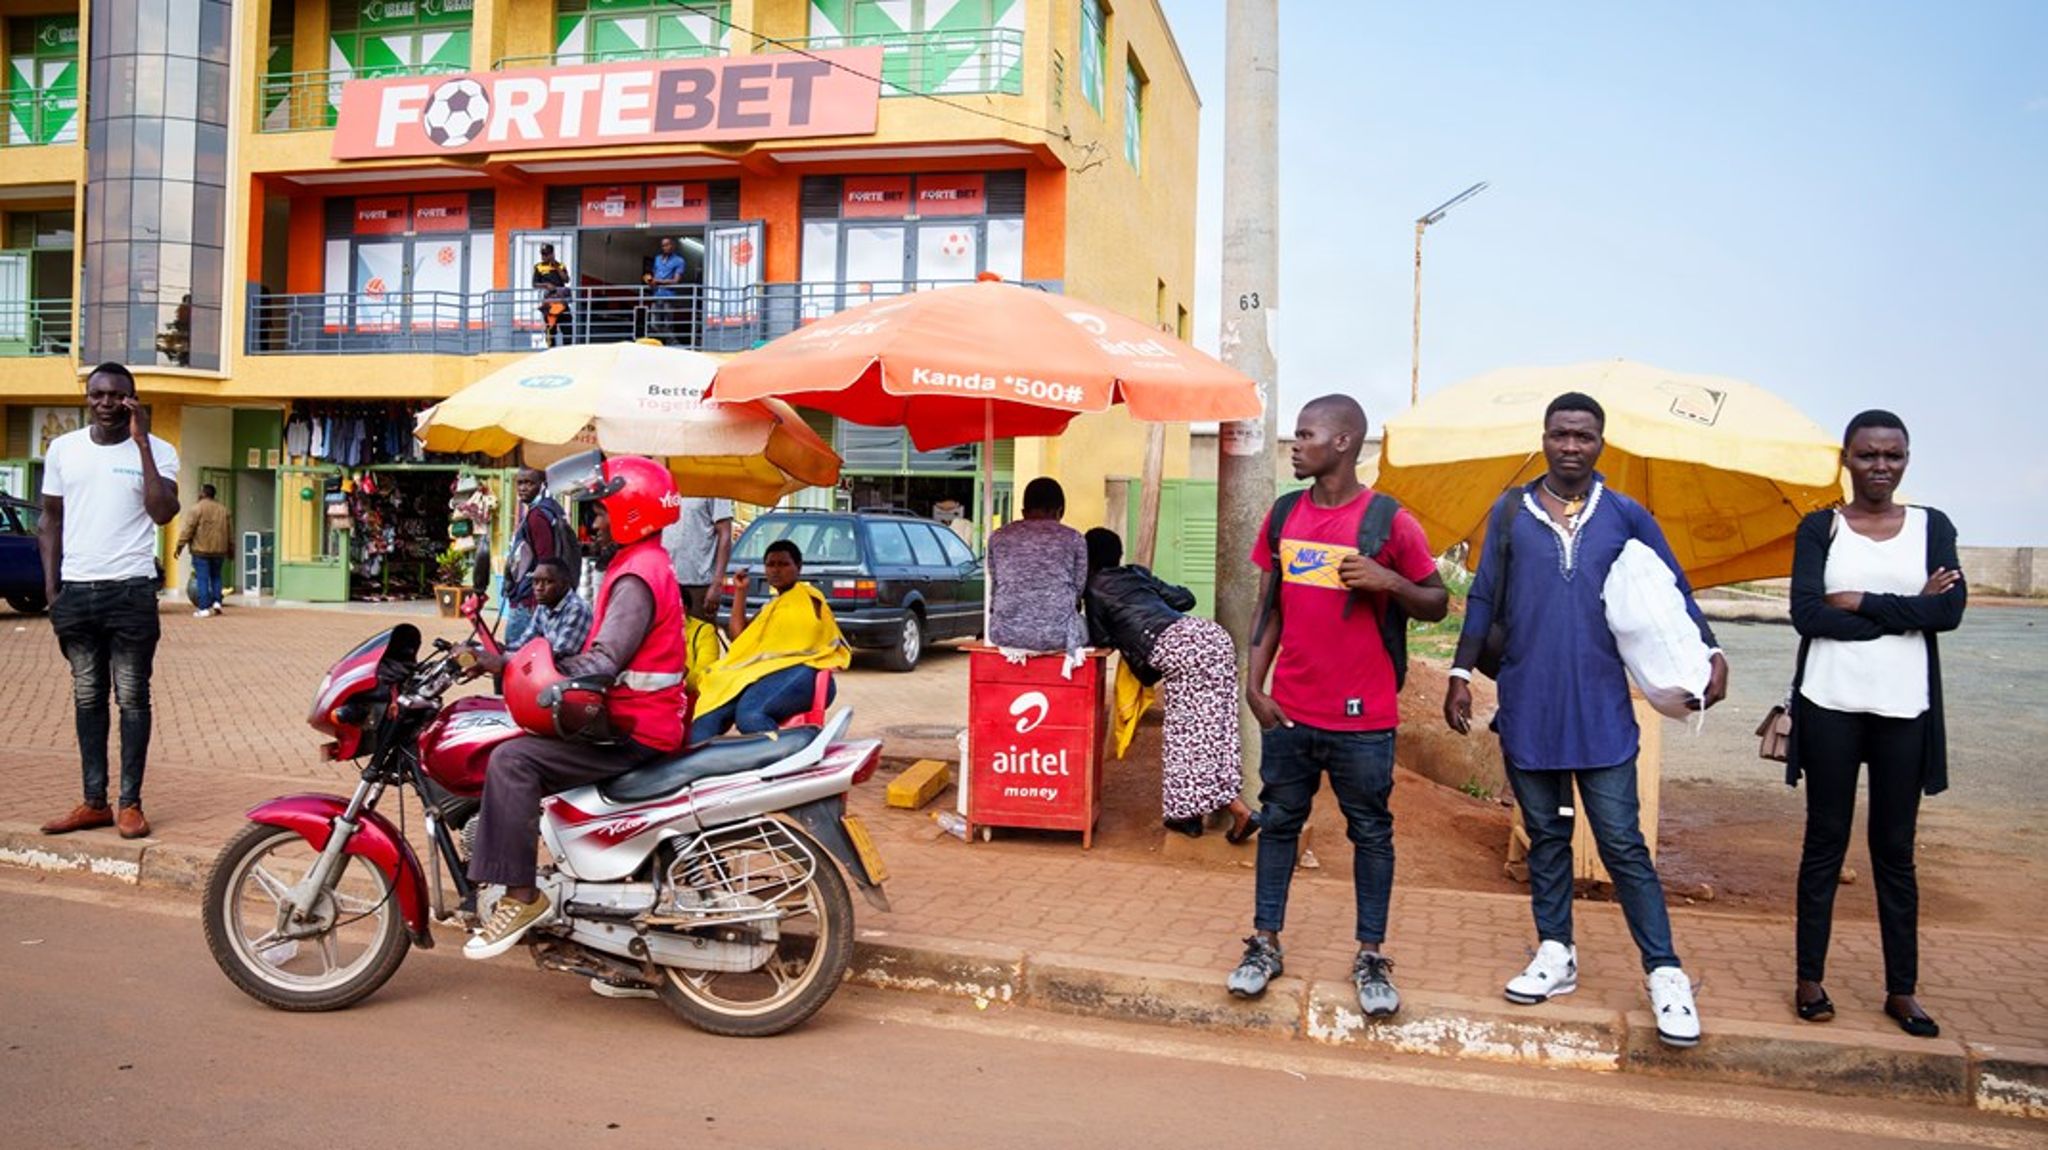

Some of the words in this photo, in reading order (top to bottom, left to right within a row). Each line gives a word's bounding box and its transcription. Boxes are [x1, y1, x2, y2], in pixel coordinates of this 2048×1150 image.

[1239, 292, 1260, 311] 63
[912, 368, 997, 391] Kanda
[1296, 548, 1328, 563] NIKE
[992, 745, 1069, 776] airtel
[1004, 787, 1058, 801] money
